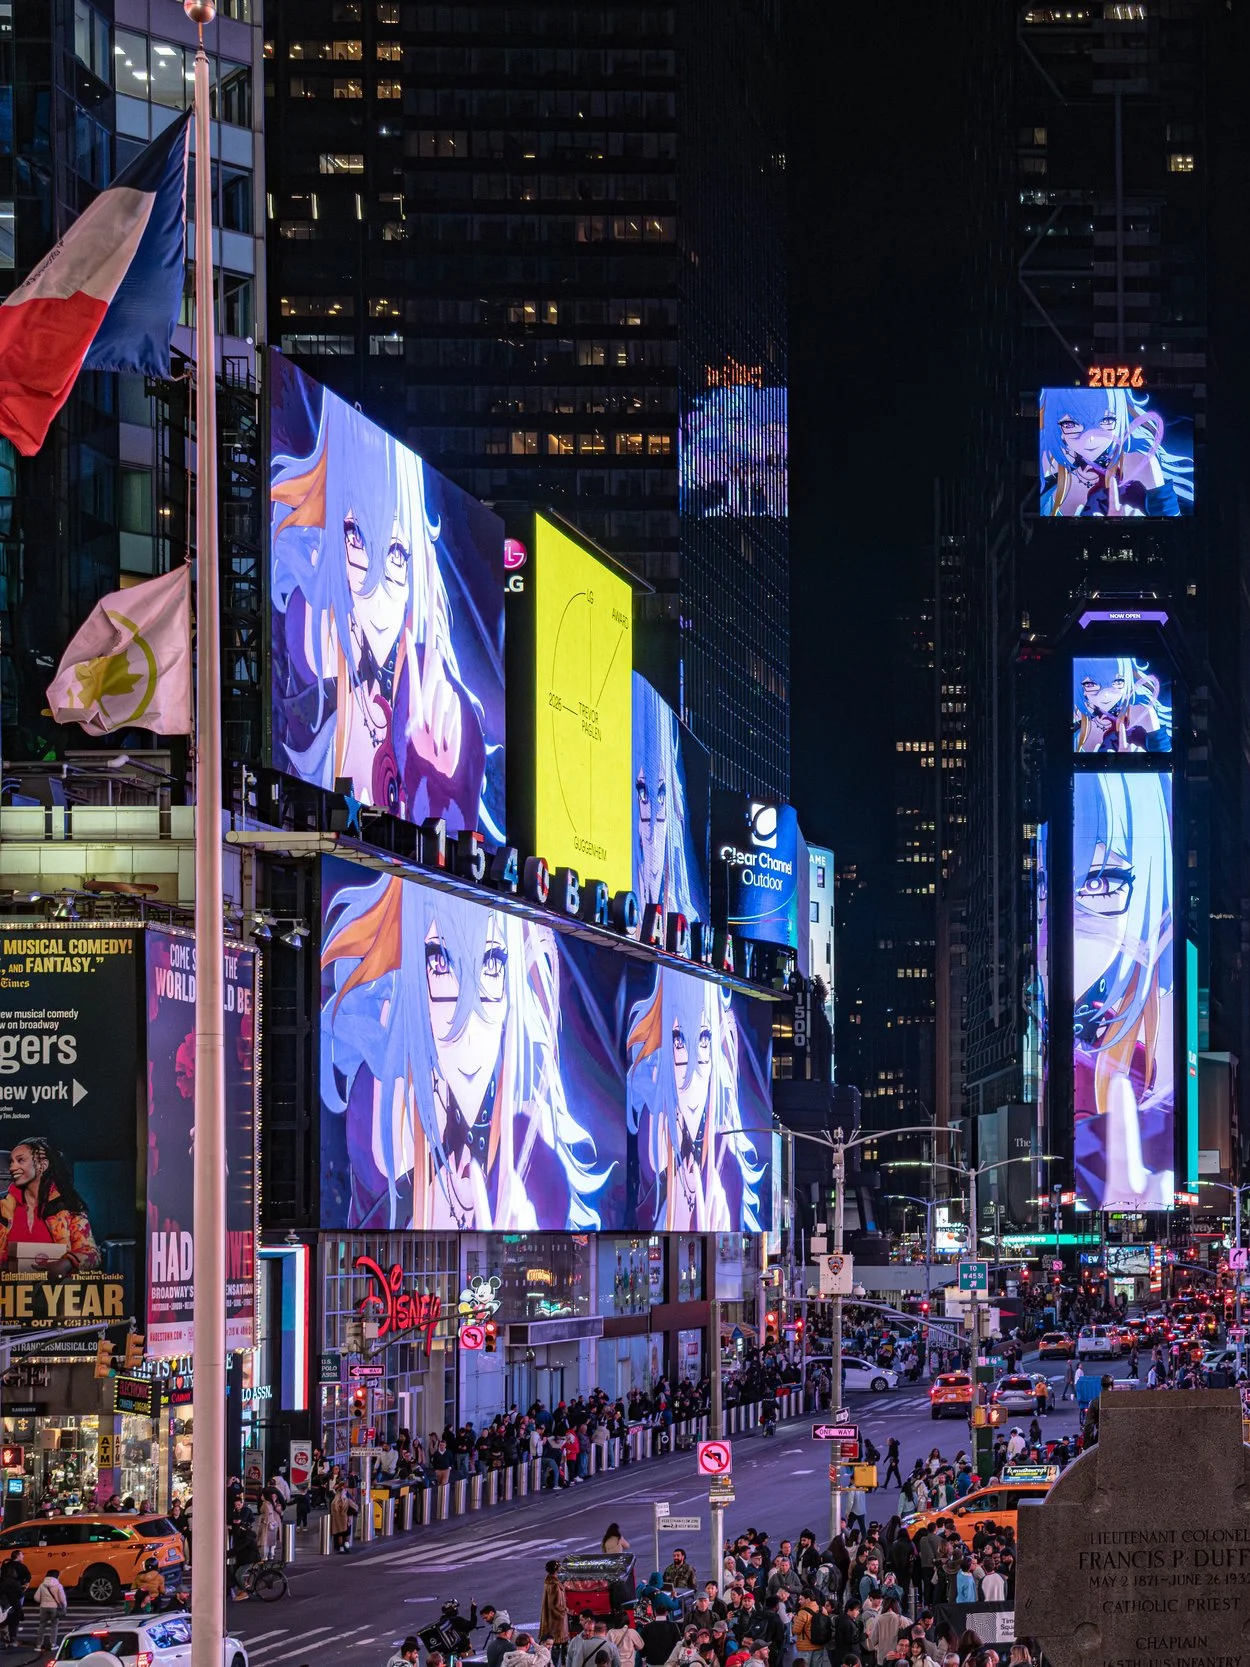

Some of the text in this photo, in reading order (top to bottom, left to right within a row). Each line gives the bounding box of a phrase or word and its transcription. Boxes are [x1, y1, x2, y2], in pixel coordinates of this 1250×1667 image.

[1088, 367, 1144, 388] 2026
[586, 589, 594, 604] LG
[611, 608, 629, 630] AWARD
[579, 702, 599, 723] TREVOR
[582, 721, 602, 742] PAGLEN
[574, 836, 607, 861] GUGGENHEIM
[721, 847, 792, 875] Clear Channel
[742, 869, 783, 891] Outdoor
[430, 818, 754, 979] 1540 BROADWAY
[4, 939, 132, 955] MUSICAL COMEDY!
[8, 963, 23, 973] AND
[170, 944, 190, 970] COME
[224, 955, 238, 980] THE
[155, 966, 196, 1003] WORLD
[237, 986, 252, 1015] BE
[14, 1008, 46, 1018] musical
[47, 1009, 79, 1020] comedy
[19, 1020, 60, 1031] broadway
[0, 1033, 78, 1074] gers
[0, 1080, 69, 1104] ew york
[42, 1284, 124, 1317] YEAR
[252, 1385, 273, 1400] ASSN.
[101, 1437, 110, 1463] ATM
[1090, 1531, 1177, 1545] LIEUTENANT
[1079, 1551, 1165, 1570] FRANCIS
[1089, 1575, 1117, 1588] MAY
[1121, 1576, 1129, 1587] 2
[1207, 1573, 1220, 1586] 26
[1102, 1597, 1241, 1614] CATHOLIC PRIEST
[1135, 1636, 1208, 1650] CHAPLAIN
